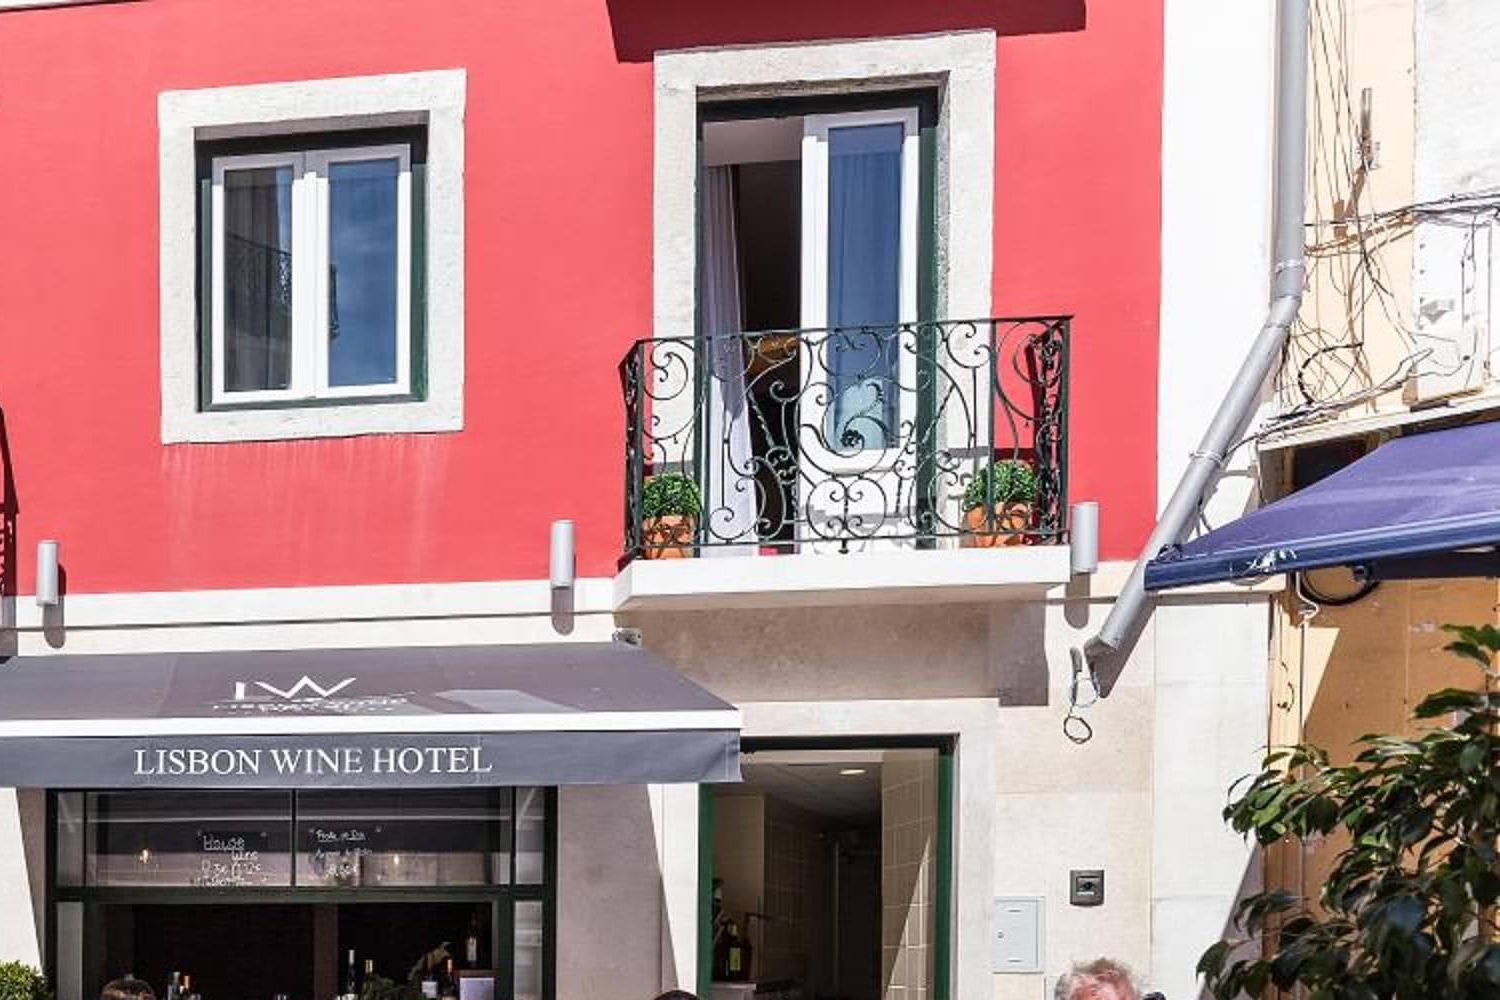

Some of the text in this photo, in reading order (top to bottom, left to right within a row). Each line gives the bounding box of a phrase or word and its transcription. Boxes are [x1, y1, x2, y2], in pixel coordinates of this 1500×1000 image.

[133, 745, 494, 776] LISBON WINE HOTEL
